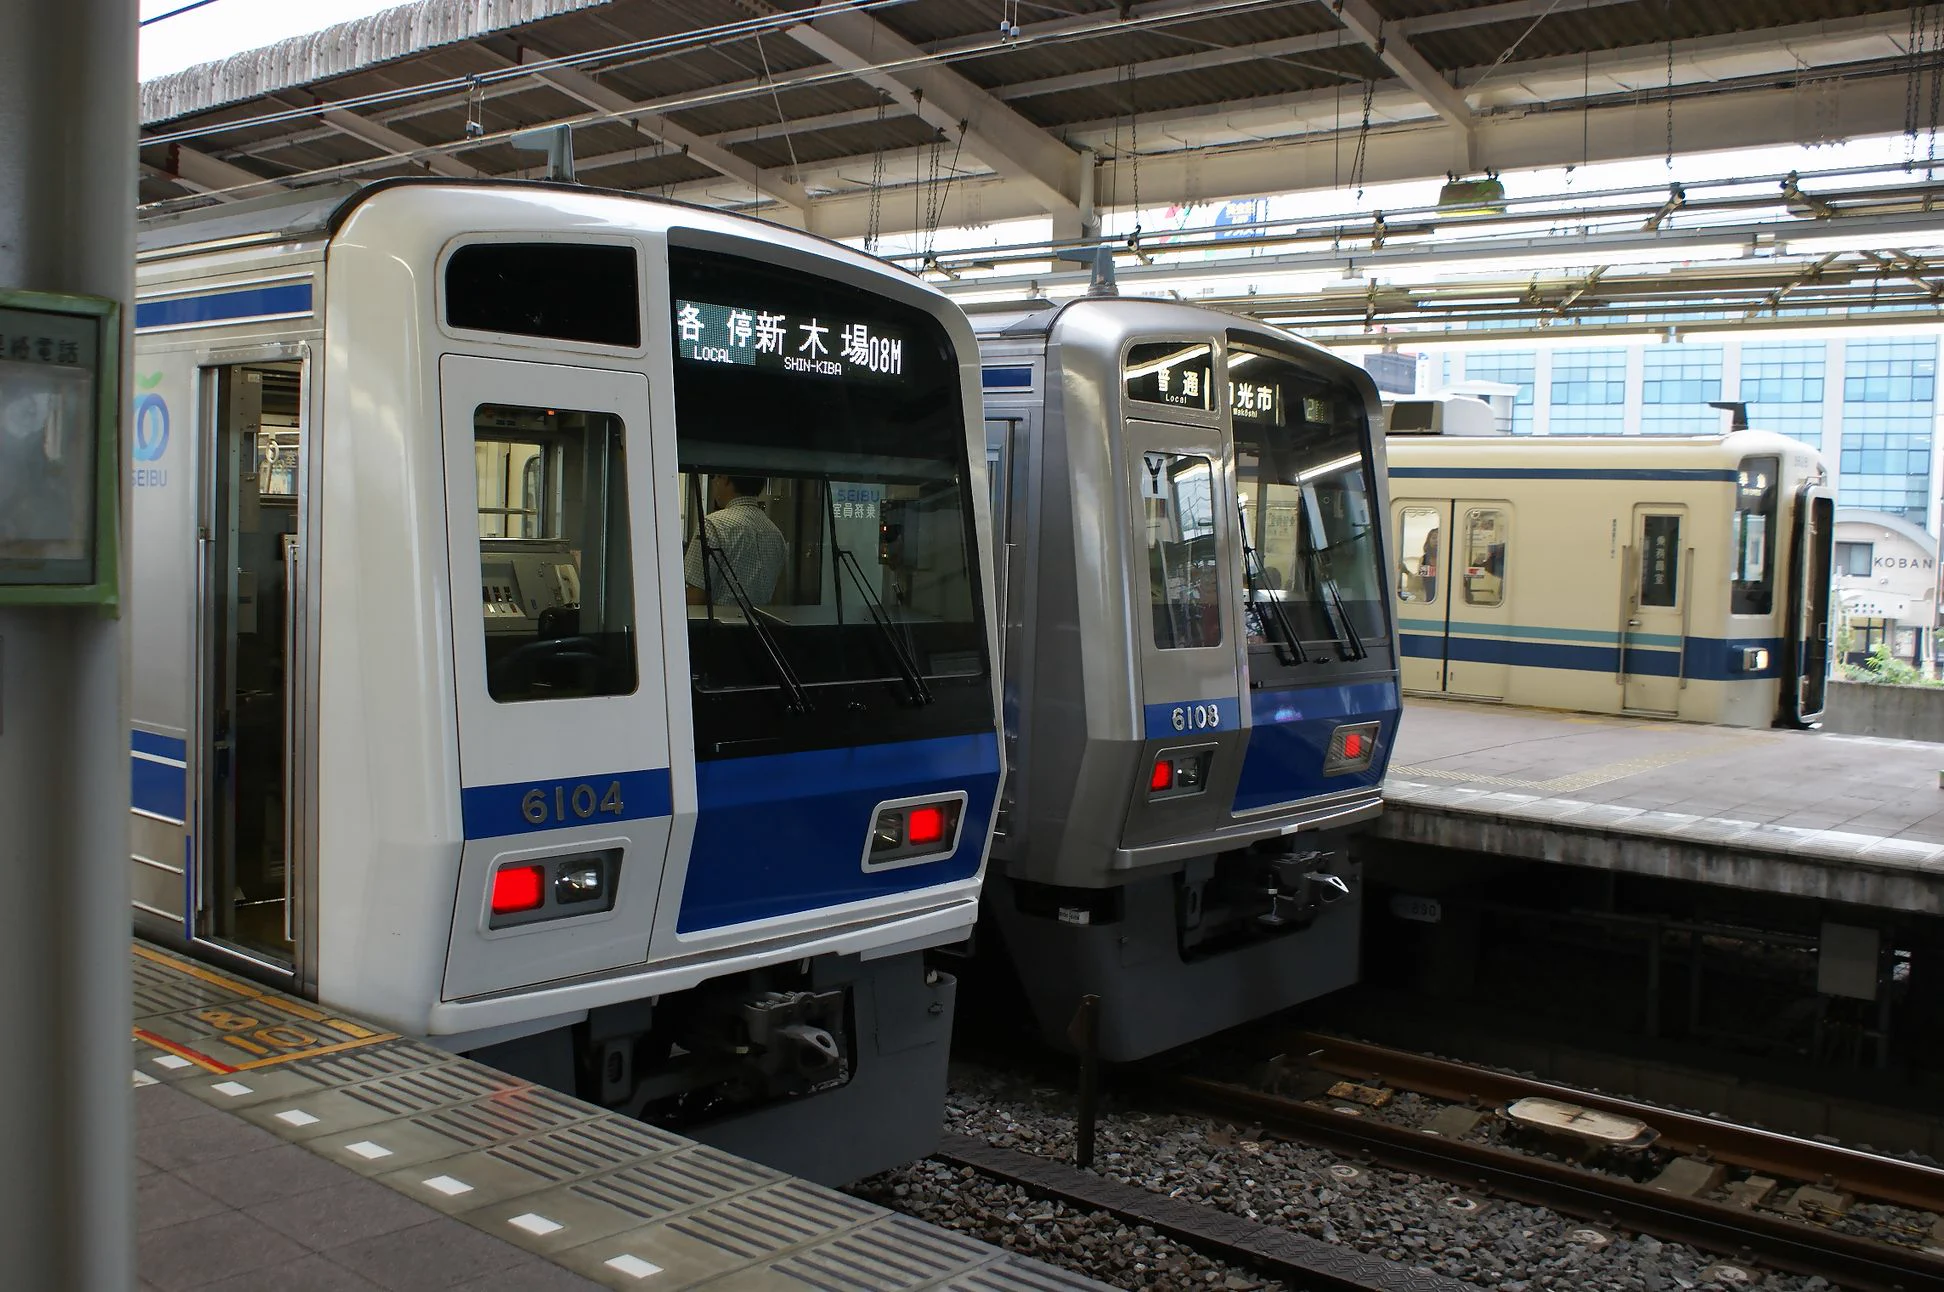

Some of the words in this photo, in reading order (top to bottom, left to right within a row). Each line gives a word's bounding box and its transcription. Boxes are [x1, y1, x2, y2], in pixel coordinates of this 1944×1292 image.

[755, 311, 869, 366] 新木場
[868, 337, 901, 375] 08M
[694, 345, 733, 364] LOCAL
[784, 356, 842, 376] SHIN-KIBA
[1158, 368, 1199, 397] 普通
[1229, 381, 1273, 411] 光市
[1165, 394, 1187, 404] Local
[1143, 456, 1165, 495] Y
[837, 488, 881, 504] SEIBU
[1873, 556, 1933, 570] KOBAN
[1171, 703, 1220, 731] 6108
[521, 780, 625, 824] 6104
